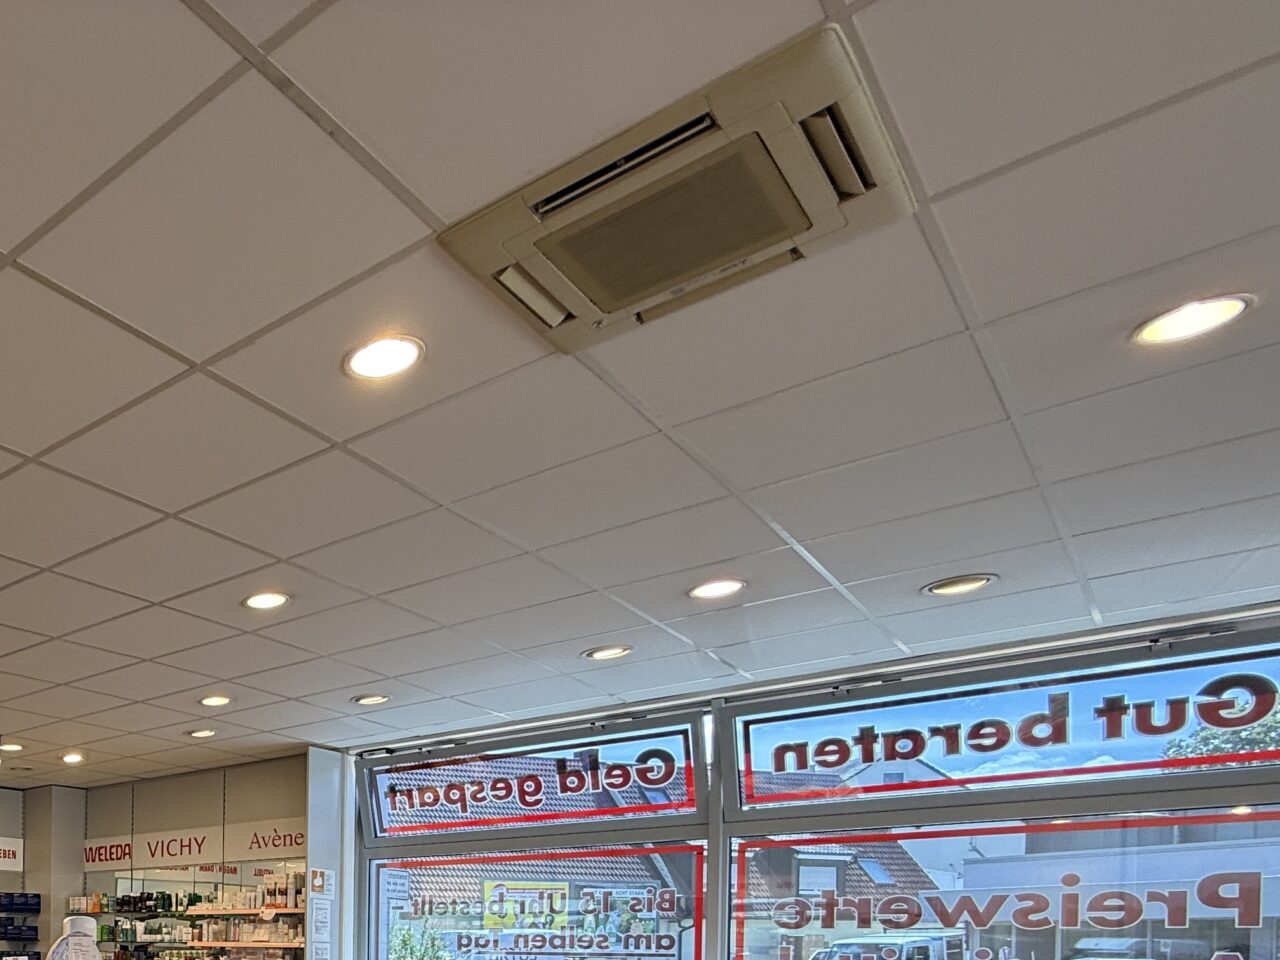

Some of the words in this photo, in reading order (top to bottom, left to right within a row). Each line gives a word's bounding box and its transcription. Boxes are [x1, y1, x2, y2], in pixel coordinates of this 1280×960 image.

[146, 836, 207, 858] VICHY
[248, 828, 306, 850] Avène
[83, 843, 132, 863] WELEDA
